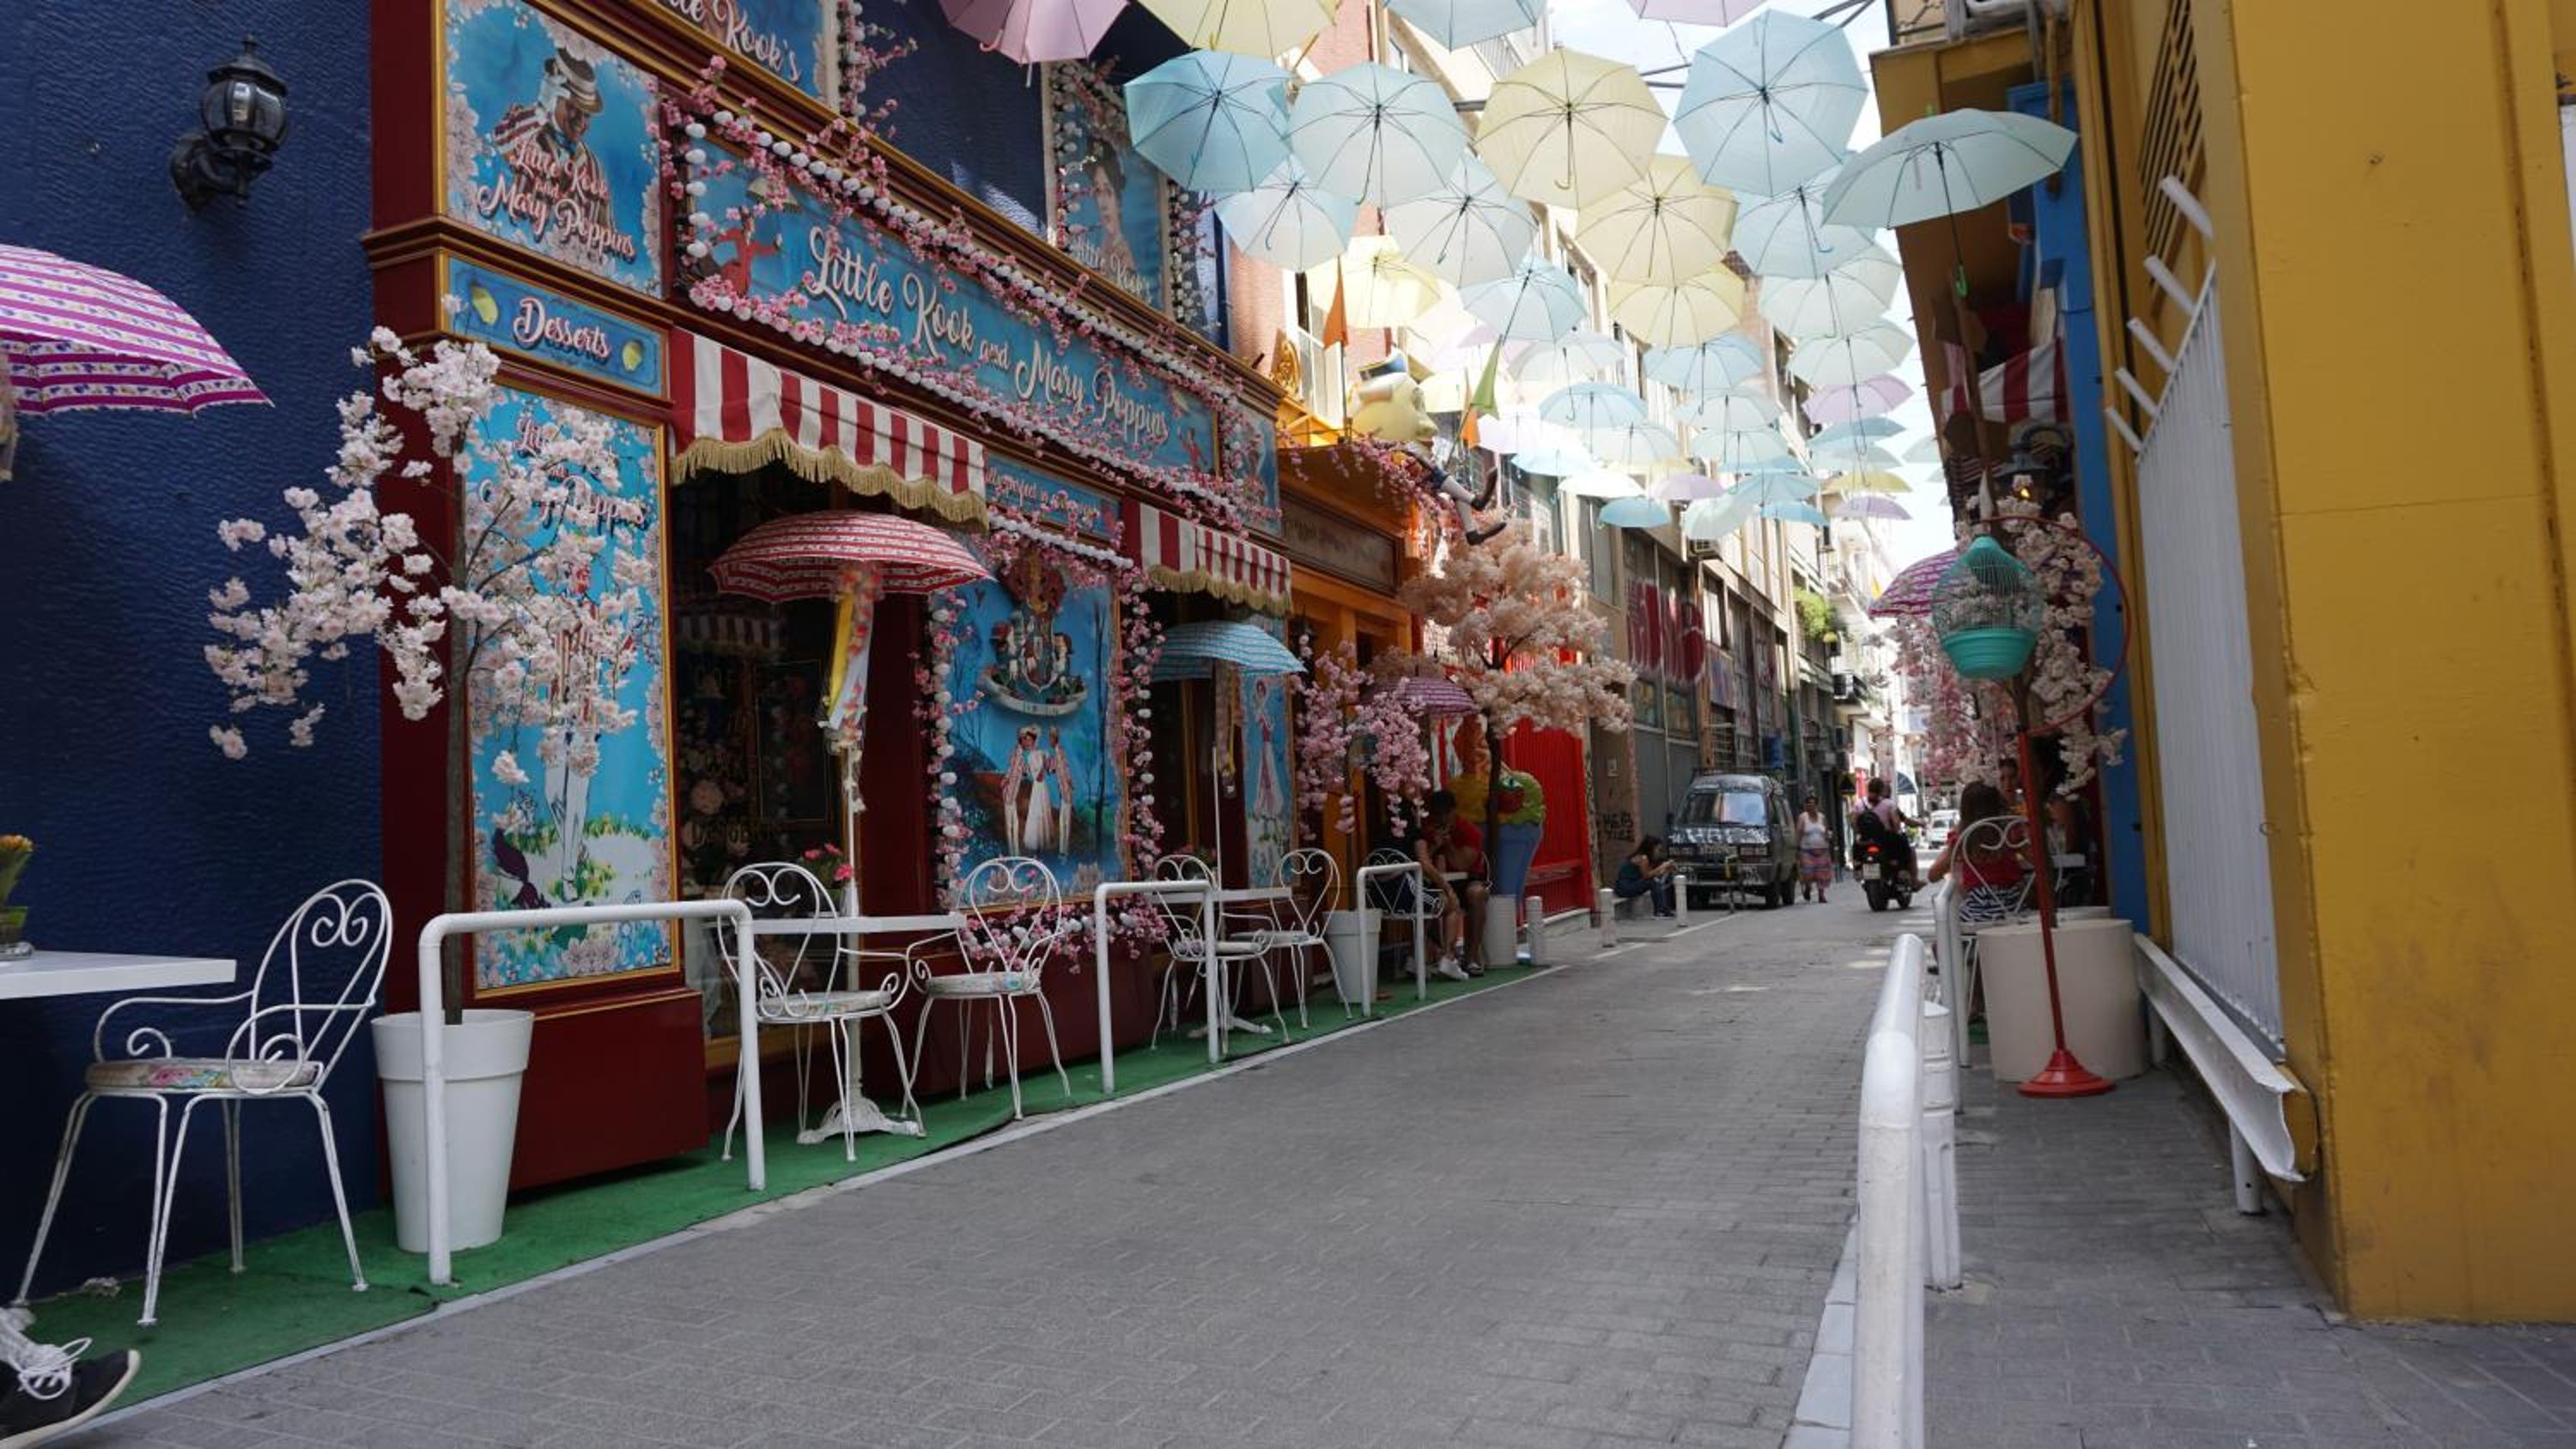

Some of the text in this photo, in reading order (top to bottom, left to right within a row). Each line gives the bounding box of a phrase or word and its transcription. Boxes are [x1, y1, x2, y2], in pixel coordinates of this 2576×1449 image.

[478, 175, 635, 260] Mary Poppins
[513, 296, 611, 358] Desserts
[805, 226, 1168, 445] Little Kook and Mary Poppins
